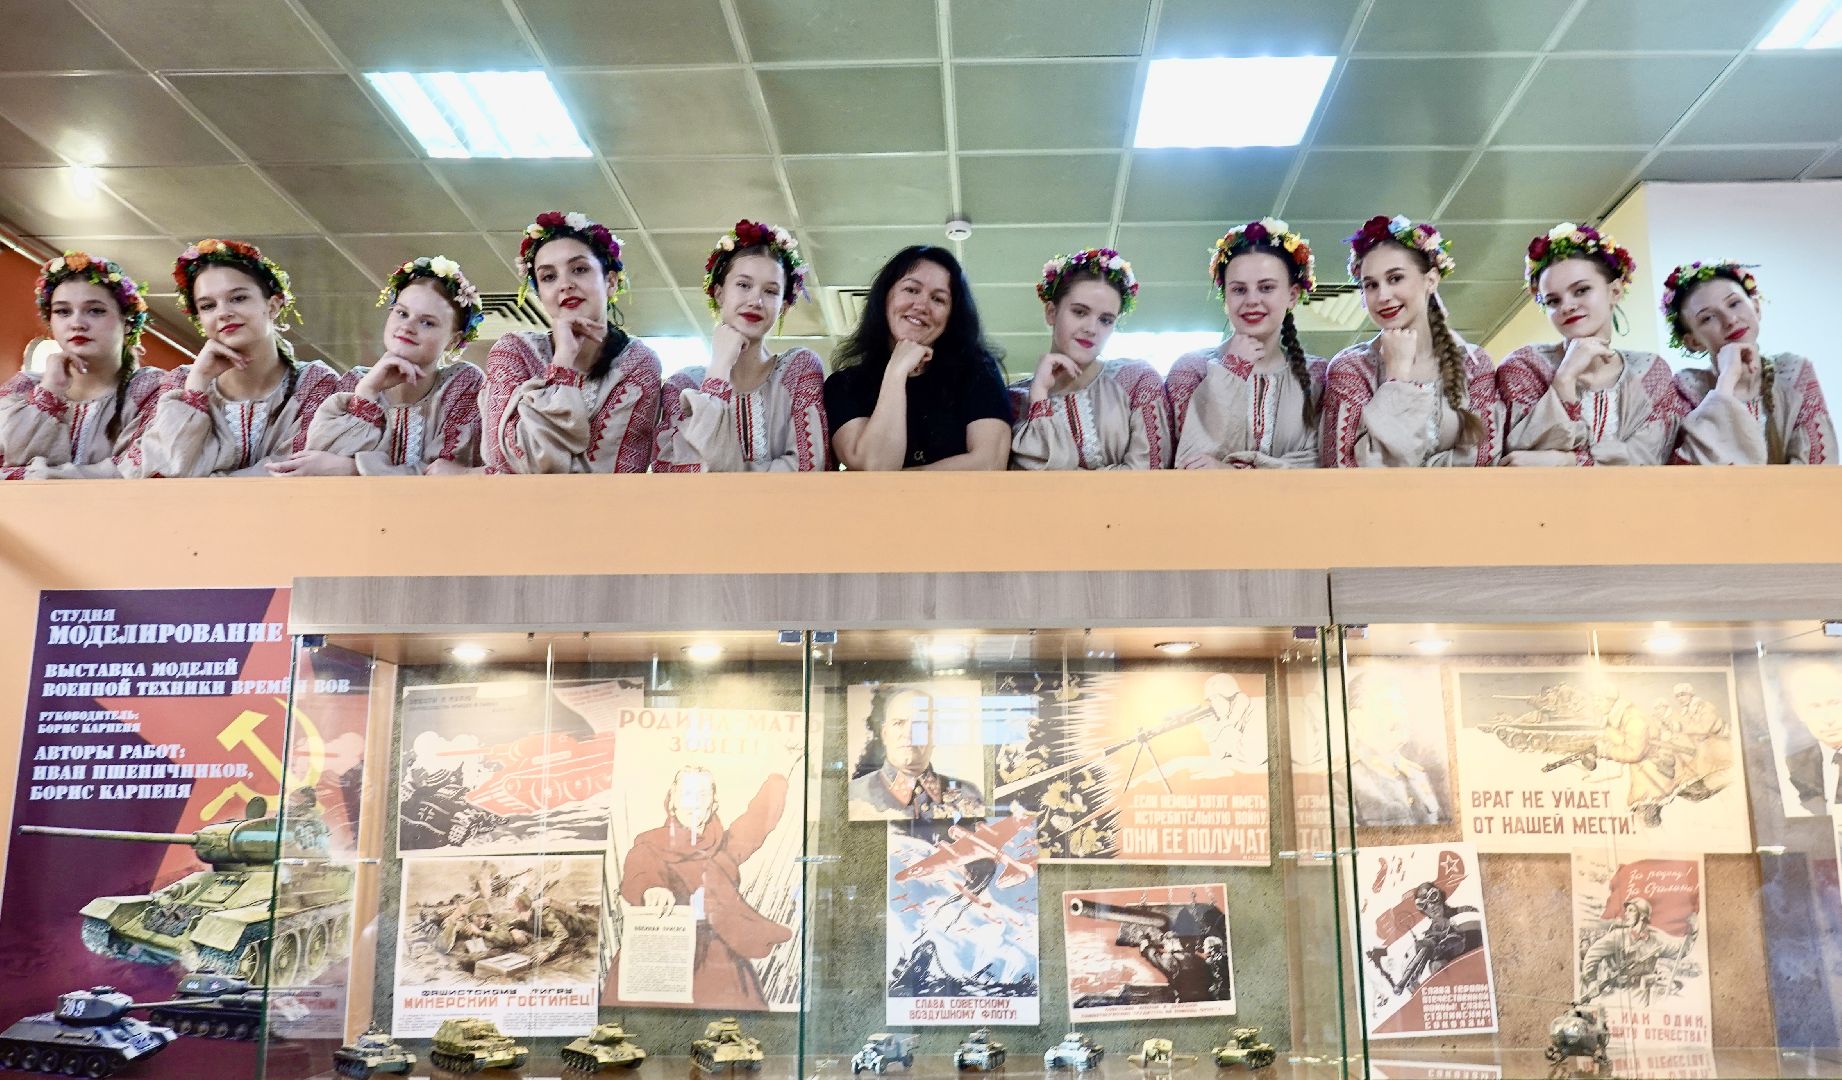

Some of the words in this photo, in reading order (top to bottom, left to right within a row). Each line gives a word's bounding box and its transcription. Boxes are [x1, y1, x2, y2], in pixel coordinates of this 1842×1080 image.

[50, 609, 115, 623] СТУДИЯ
[48, 623, 283, 648] МОДЕЛИРОВАНИЕ
[44, 663, 146, 678] ВЫСТАВКА
[150, 658, 238, 678] МОДЕЛЕЙ
[42, 678, 131, 697] ВОЕННОЙ
[137, 681, 226, 696] ТЕХНИКИ
[313, 679, 350, 694] ВОВ
[39, 710, 139, 722] РУКОВОДИТЕЛЬ:
[37, 723, 79, 734] БОРИС
[81, 722, 141, 733] КАРПЕНЯ
[33, 745, 115, 760] АВТОРЫ
[119, 744, 186, 759] РАБОТ:
[32, 765, 87, 780] ИВАН
[92, 764, 254, 779] ПШЕНИЧНИКОВ,
[30, 785, 95, 800] БОРИС
[99, 784, 192, 799] КАРПЕНЯ
[1471, 790, 1513, 808] ВРАГ
[1522, 791, 1544, 808] НЕ
[1552, 787, 1610, 809] УЙДЕТ
[1134, 810, 1231, 825] ИСТРЕБИТЕЛЬНУЮ
[1474, 816, 1494, 834] ОТ
[1502, 813, 1564, 834] НАШЕЙ
[1573, 814, 1637, 834] МЕСТИ!
[1122, 828, 1158, 854] ОНИ
[1162, 828, 1184, 853] ЕЕ
[507, 987, 595, 1007] ГОСТИНЕЦ!
[1421, 985, 1451, 995] СЛАВА
[915, 999, 945, 1009] СЛАВА
[950, 998, 1010, 1009] СОВЕТСКОМУ
[1461, 1001, 1491, 1011] СЛАВА
[909, 1009, 975, 1020] ВОЗДУШНОМУ
[981, 1009, 1017, 1020] ФЛОТУ!
[1424, 1009, 1491, 1021] СТАЛИНСКИМ
[1621, 1011, 1650, 1025] КАК
[1645, 1028, 1707, 1043] ОТЕЧЕСТВА!
